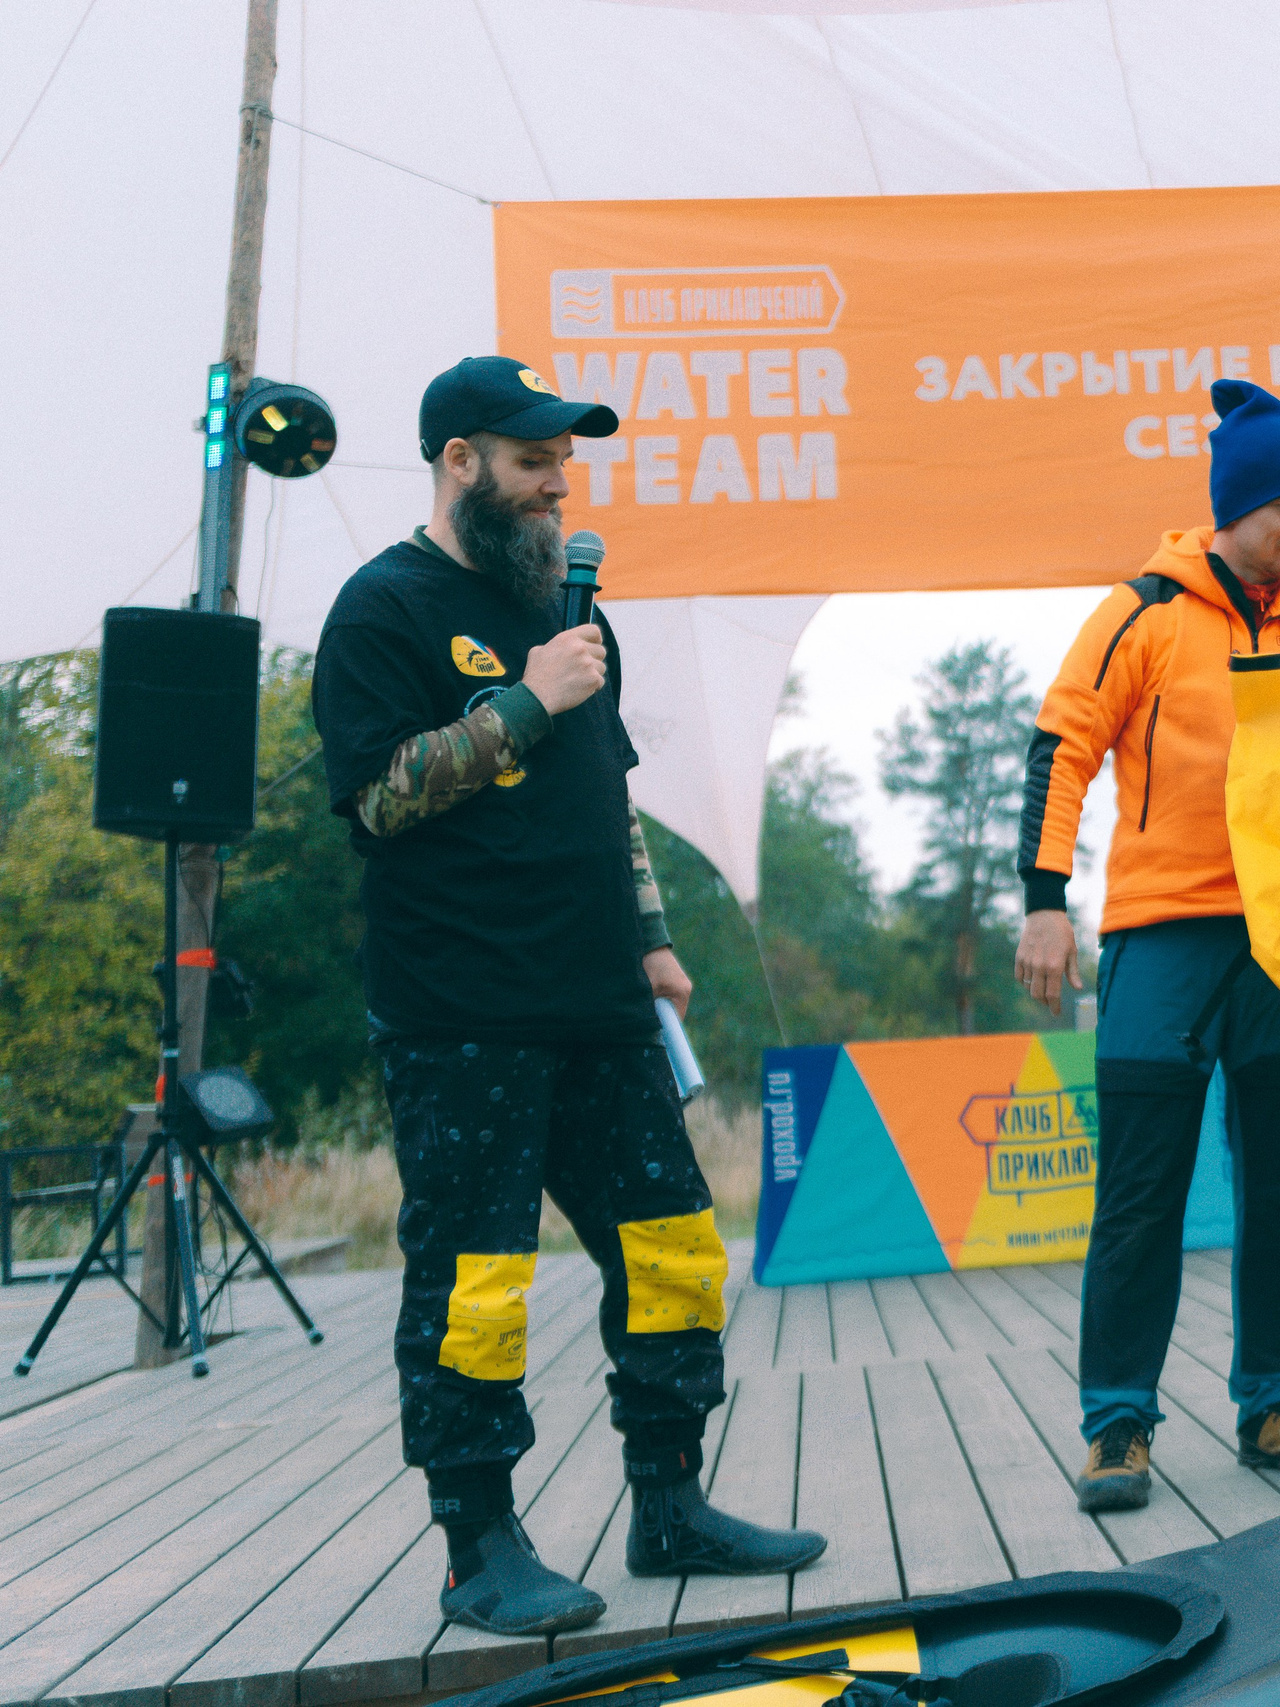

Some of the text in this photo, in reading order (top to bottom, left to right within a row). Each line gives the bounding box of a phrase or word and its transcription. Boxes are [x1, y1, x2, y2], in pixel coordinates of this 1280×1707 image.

[623, 279, 824, 323] КЛУБ ПРИКЛЮЧЕНИЙ
[551, 347, 850, 420] WATER
[914, 346, 1251, 401] ЗАКРЫТИЕ
[572, 432, 838, 506] TEAM
[763, 1072, 803, 1183] vpoxod.ru
[994, 1103, 1052, 1135] КЛУБ
[998, 1144, 1097, 1183] ПРИКЛЮ
